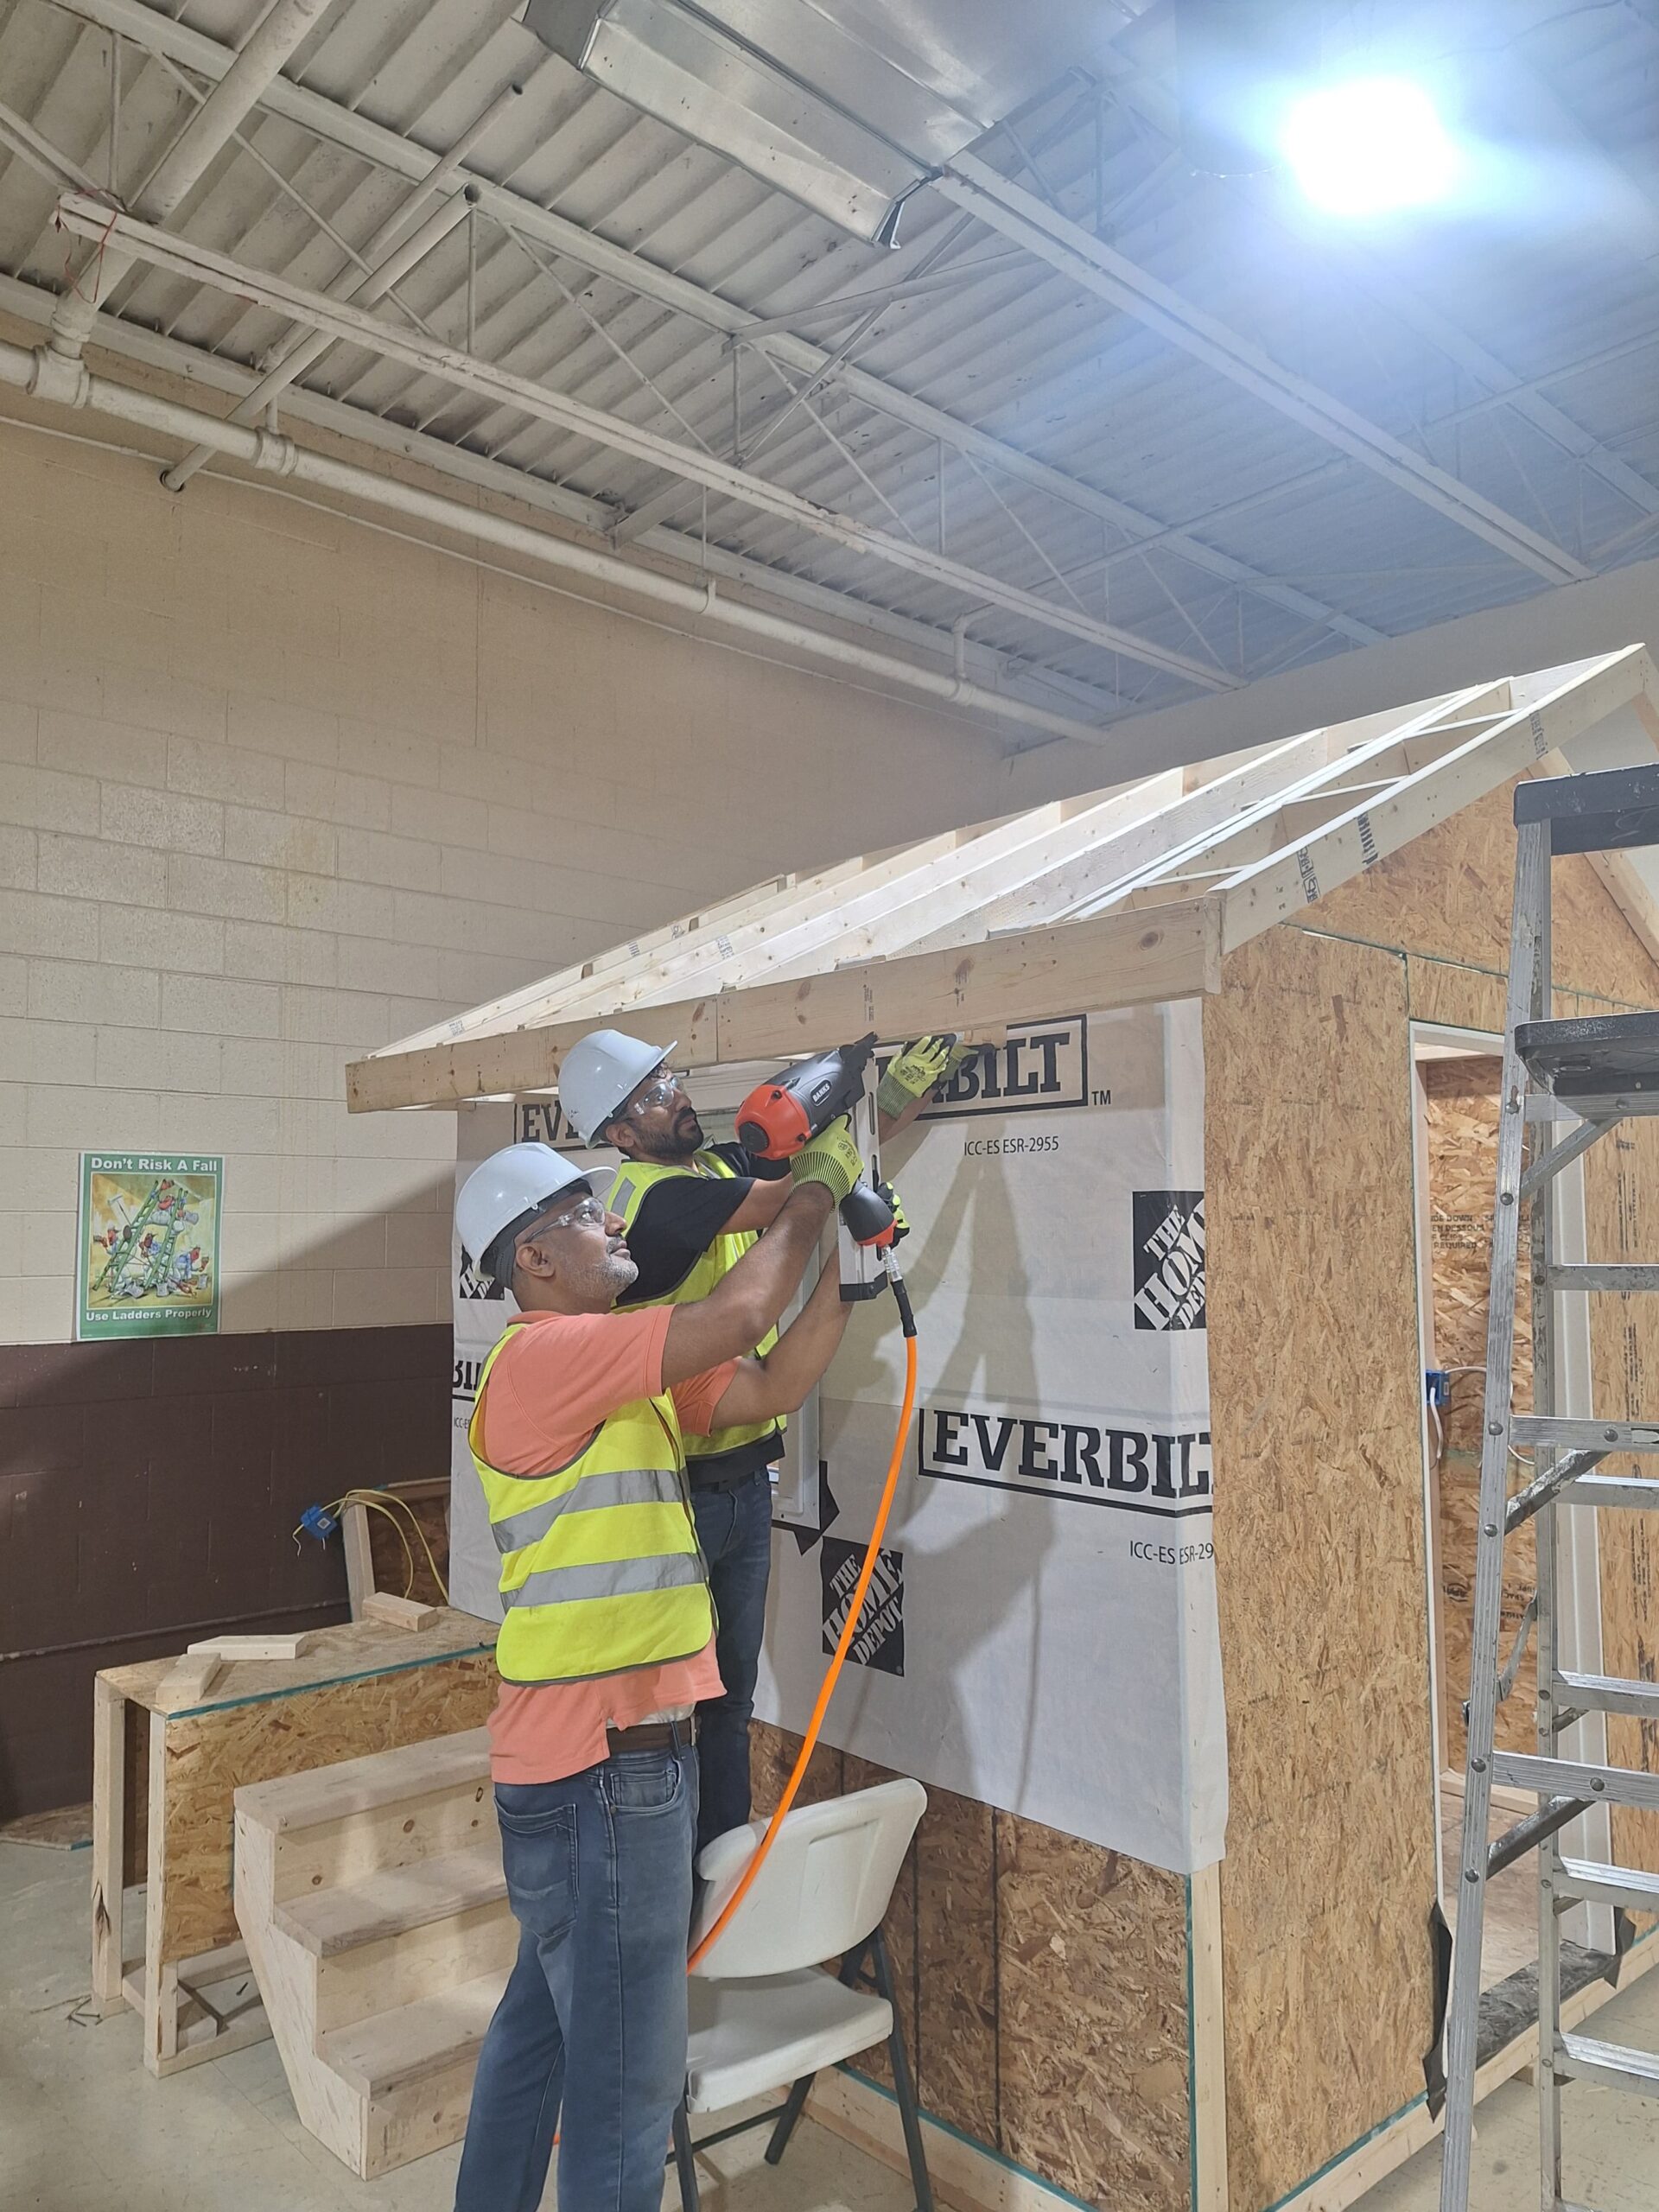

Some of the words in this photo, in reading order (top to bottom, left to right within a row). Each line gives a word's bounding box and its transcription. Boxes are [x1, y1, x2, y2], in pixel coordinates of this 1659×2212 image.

[812, 1082, 830, 1103] BANKS
[1091, 1090, 1111, 1106] TM
[963, 1140, 1001, 1157] ICC-ES
[1002, 1135, 1060, 1154] ESR-2955
[91, 1157, 133, 1171] Don't
[138, 1158, 172, 1172] Risk
[176, 1159, 188, 1172] A
[193, 1160, 217, 1172] Fall
[1142, 1204, 1185, 1262] THE
[86, 1313, 109, 1322] Use
[112, 1308, 162, 1320] Ladders
[165, 1307, 213, 1319] Properly
[932, 1409, 1212, 1499] EVERBIL
[1129, 1540, 1176, 1565] ICC-ES
[830, 1554, 862, 1599] THE
[852, 1596, 904, 1666] DEPOT
